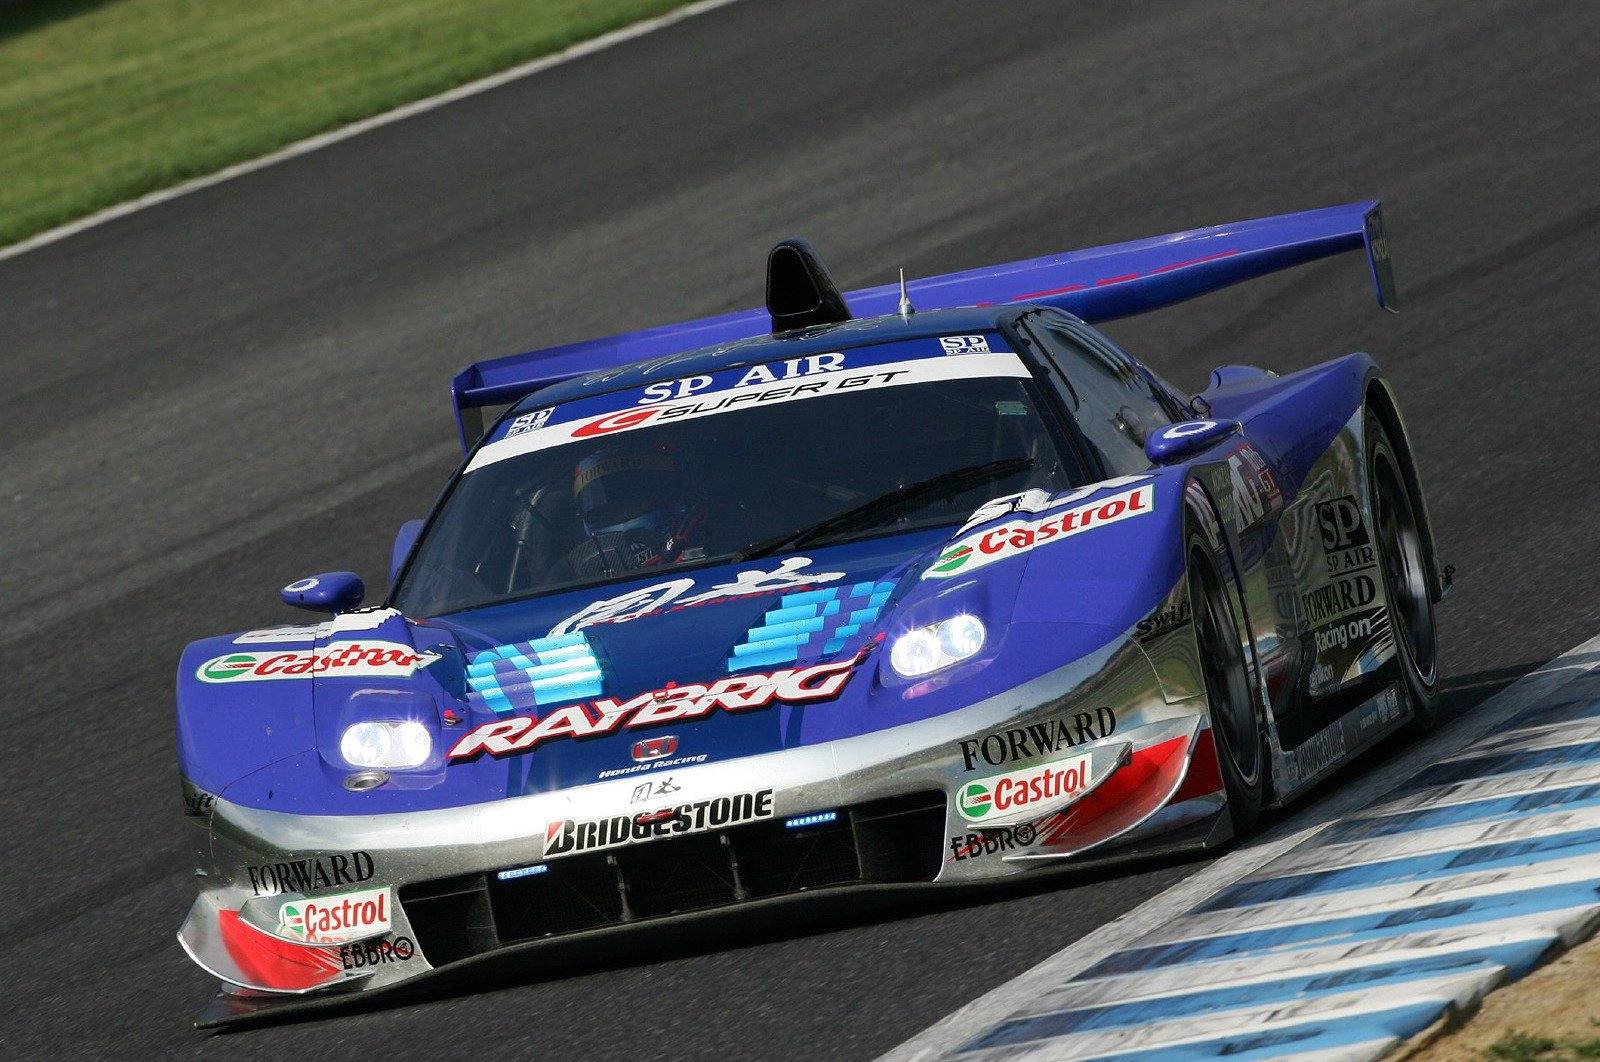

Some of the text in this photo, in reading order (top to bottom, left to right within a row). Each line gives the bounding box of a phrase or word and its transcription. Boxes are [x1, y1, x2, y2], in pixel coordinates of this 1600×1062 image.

[637, 352, 846, 405] SP AIR
[656, 381, 828, 421] SUPER
[838, 370, 909, 390] GT
[978, 489, 1146, 555] Castrol
[1318, 497, 1360, 550] SP
[1327, 547, 1376, 573] SP AIR
[1301, 575, 1376, 622] FORWARD
[1314, 618, 1372, 653] Racing on
[446, 652, 862, 762] RAYBRIG
[957, 705, 1117, 772] FORWARD
[598, 753, 708, 779] Honda Racing
[993, 760, 1088, 811] Castrol
[543, 788, 774, 856] BRIDGESTONE
[247, 850, 375, 897] FORWARD
[304, 893, 387, 934] Castrol
